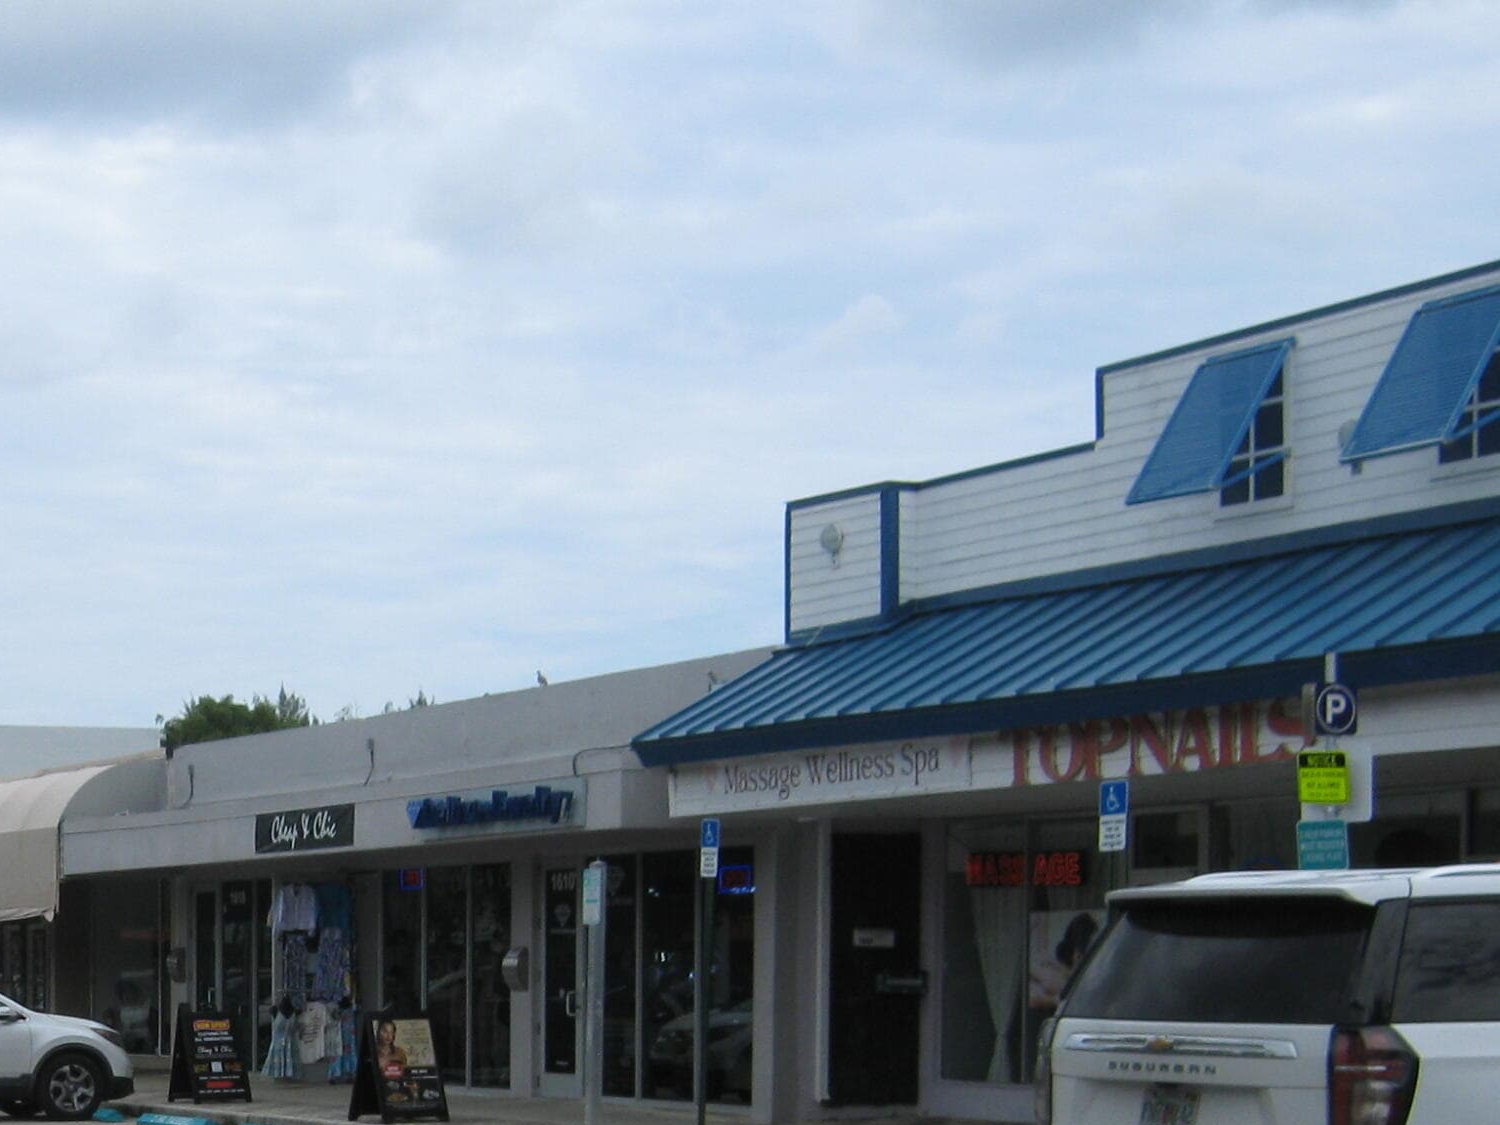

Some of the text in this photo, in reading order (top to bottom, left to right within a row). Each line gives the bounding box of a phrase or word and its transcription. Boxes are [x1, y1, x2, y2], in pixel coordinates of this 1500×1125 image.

[1326, 693, 1346, 723] P
[724, 743, 940, 799] Massage Wellness Spa
[313, 811, 336, 839] Chic
[1108, 1060, 1217, 1075] SUBURBAN
